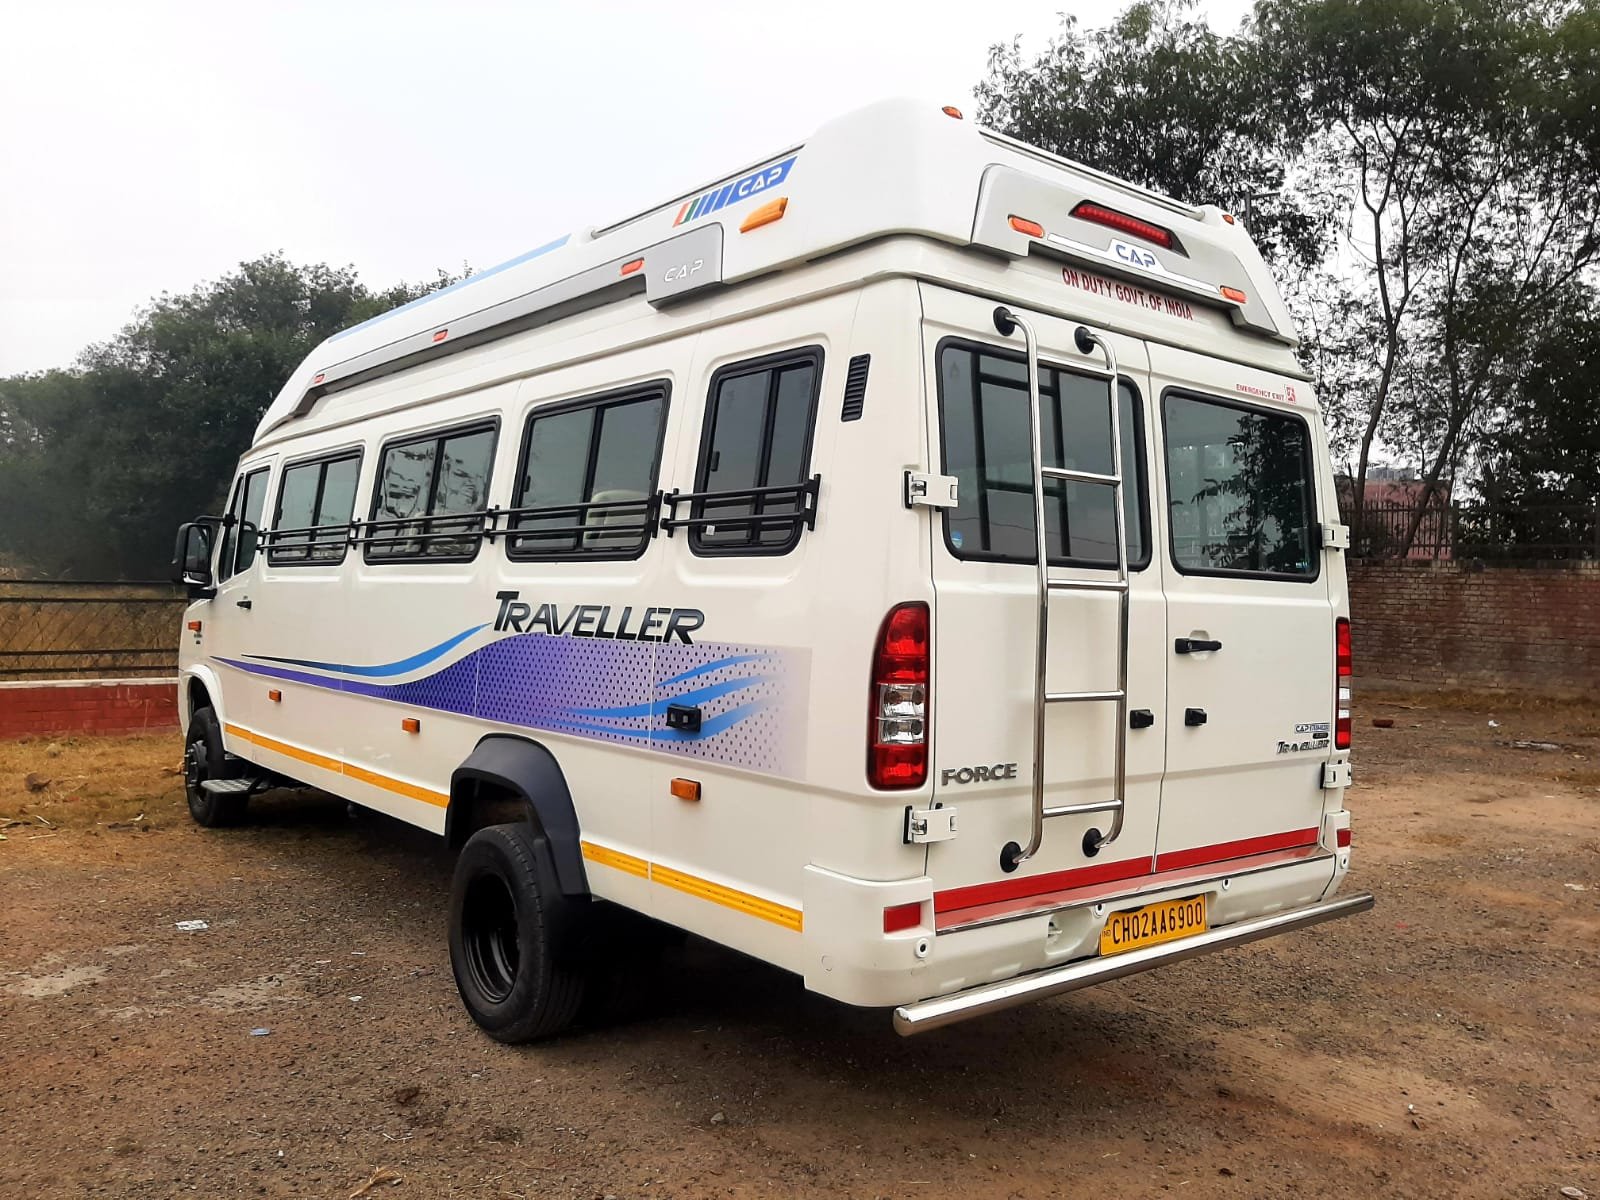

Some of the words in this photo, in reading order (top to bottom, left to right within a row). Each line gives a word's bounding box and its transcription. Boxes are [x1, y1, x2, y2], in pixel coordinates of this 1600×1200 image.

[739, 167, 783, 197] CAP
[1115, 244, 1156, 268] CAP
[664, 259, 704, 282] CAP
[1062, 267, 1079, 288] ON
[1082, 273, 1112, 298] DUTY
[1165, 298, 1193, 320] INDIA
[1235, 383, 1271, 398] EMERGENCY
[1271, 392, 1285, 401] EXIT
[493, 590, 706, 645] TRAVELLER
[941, 763, 1018, 787] FORCE
[1112, 902, 1203, 945] CH02AA6900
